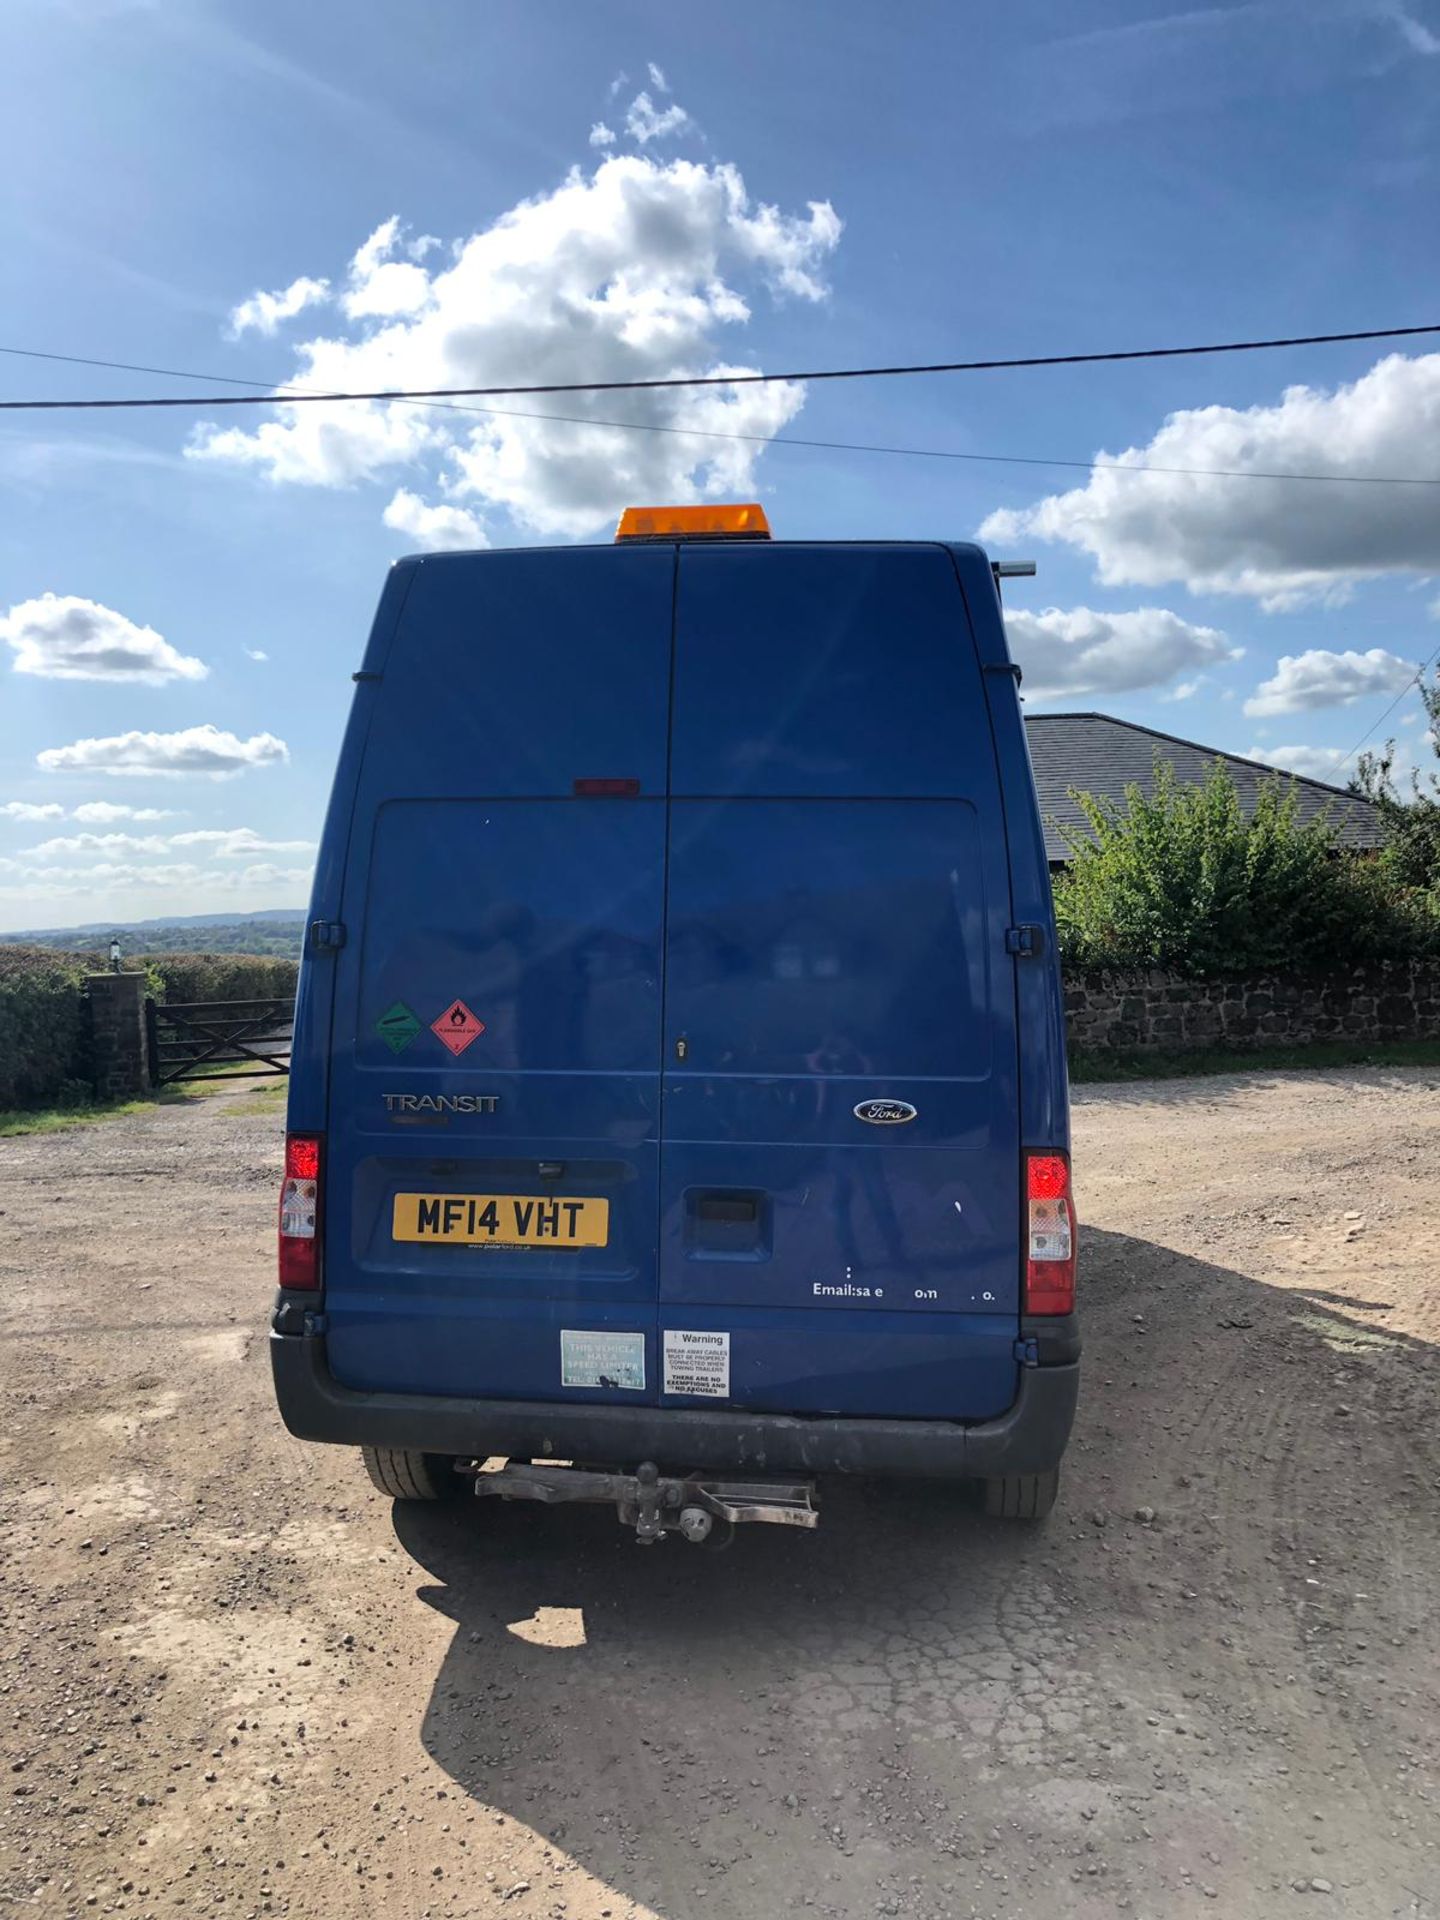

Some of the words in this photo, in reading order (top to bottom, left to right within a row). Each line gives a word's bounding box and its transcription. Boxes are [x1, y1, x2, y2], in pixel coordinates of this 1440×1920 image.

[382, 1094, 500, 1112] TRANSIT
[867, 1103, 903, 1119] Ford
[417, 1199, 499, 1235] MF14
[513, 1201, 584, 1237] VHT
[682, 1334, 723, 1346] Warning
